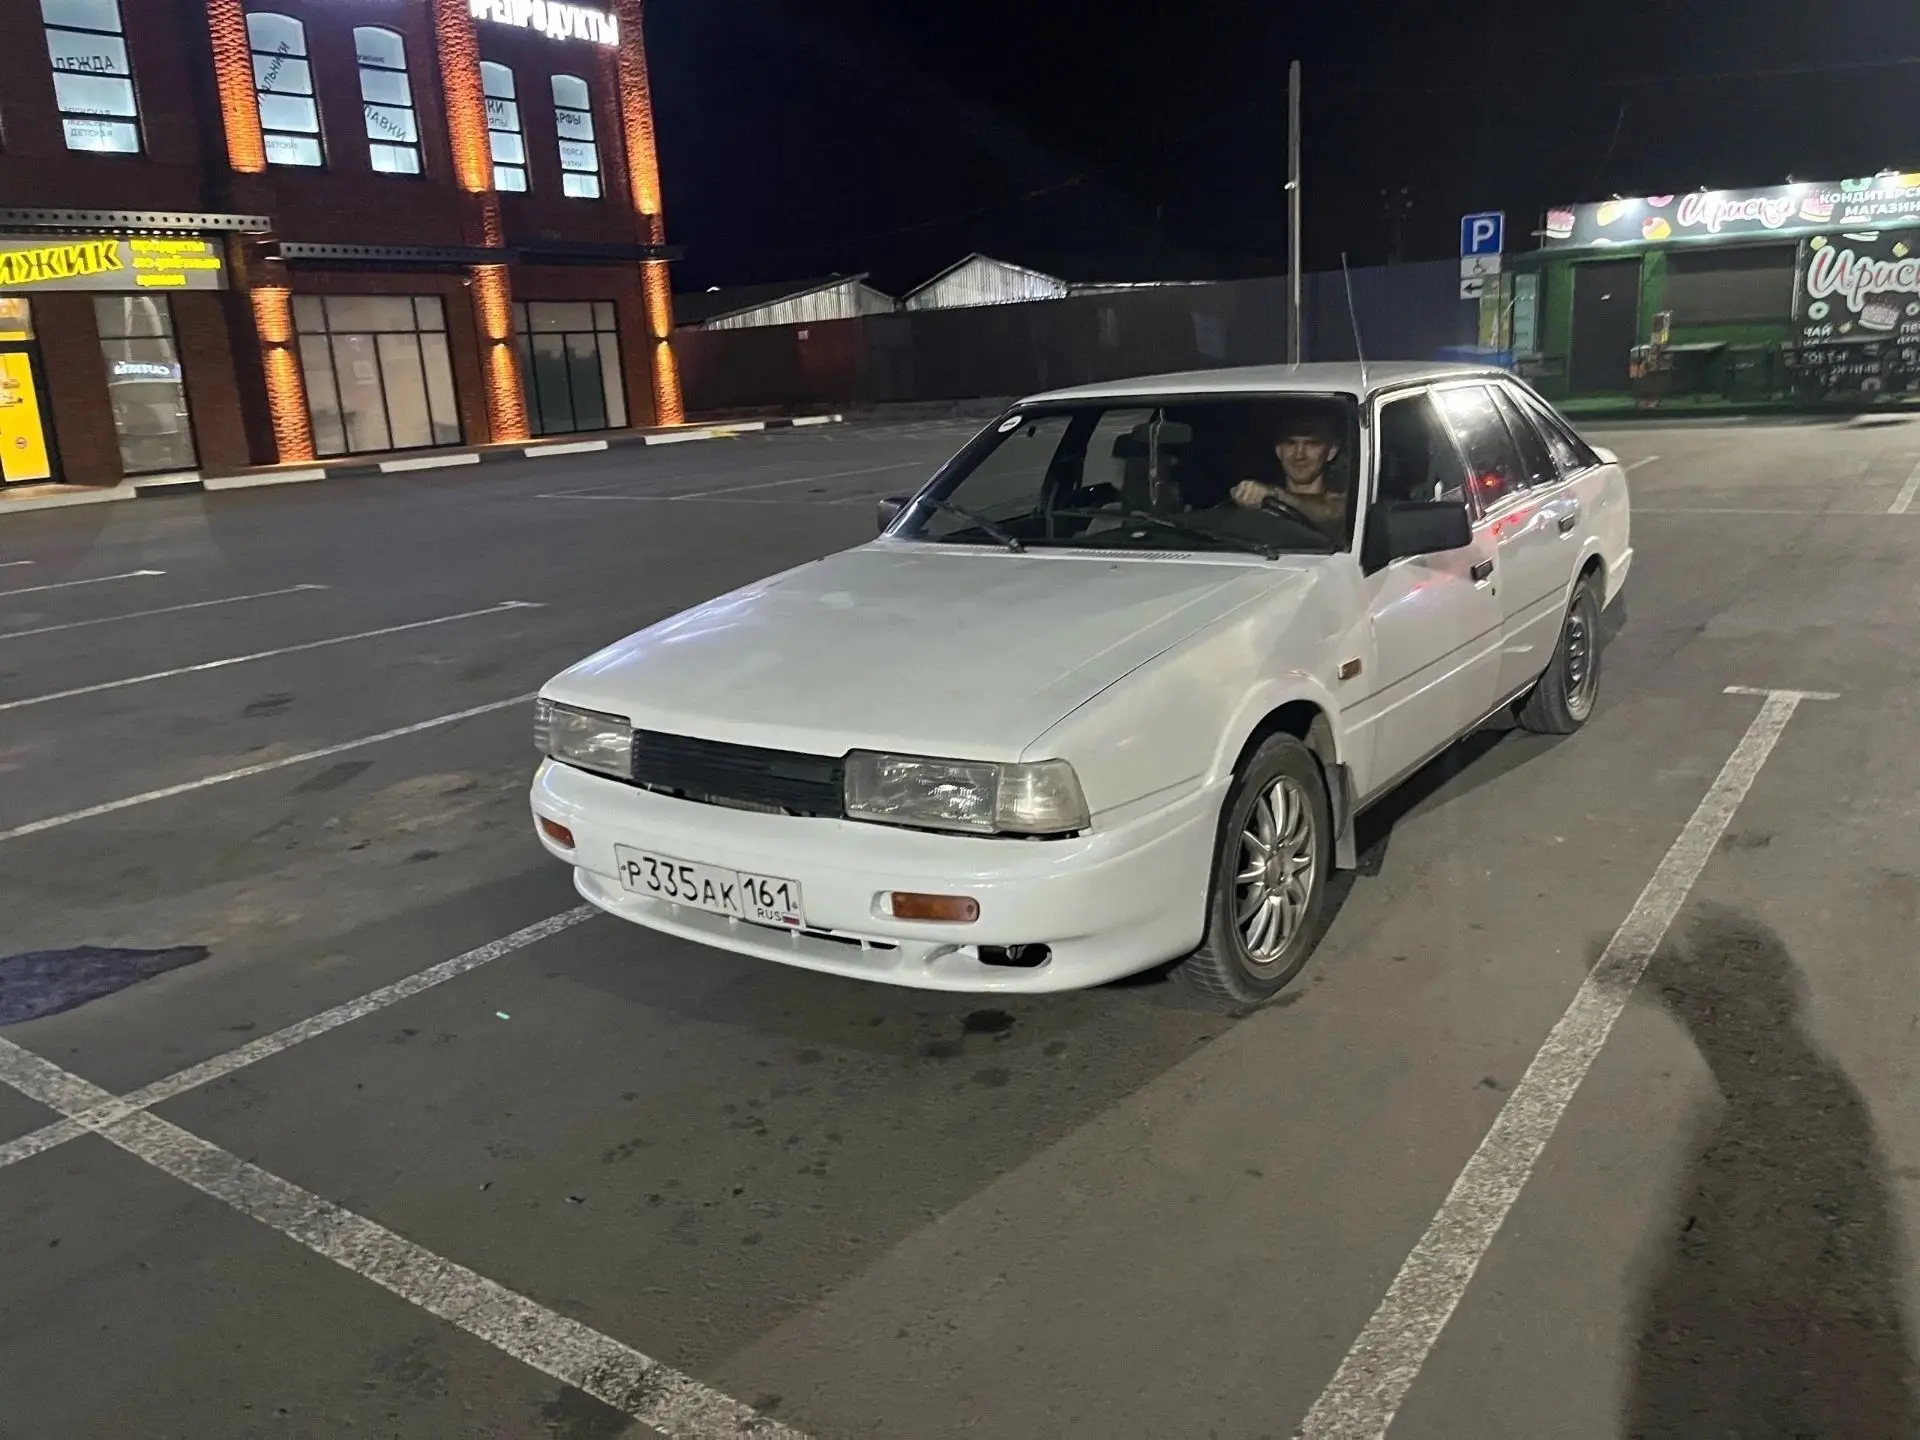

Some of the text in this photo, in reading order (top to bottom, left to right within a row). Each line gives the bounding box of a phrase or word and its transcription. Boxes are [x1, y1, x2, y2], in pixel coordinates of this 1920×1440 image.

[1472, 219, 1495, 252] P
[627, 856, 791, 911] Р335АК 161
[757, 908, 782, 922] RUS
